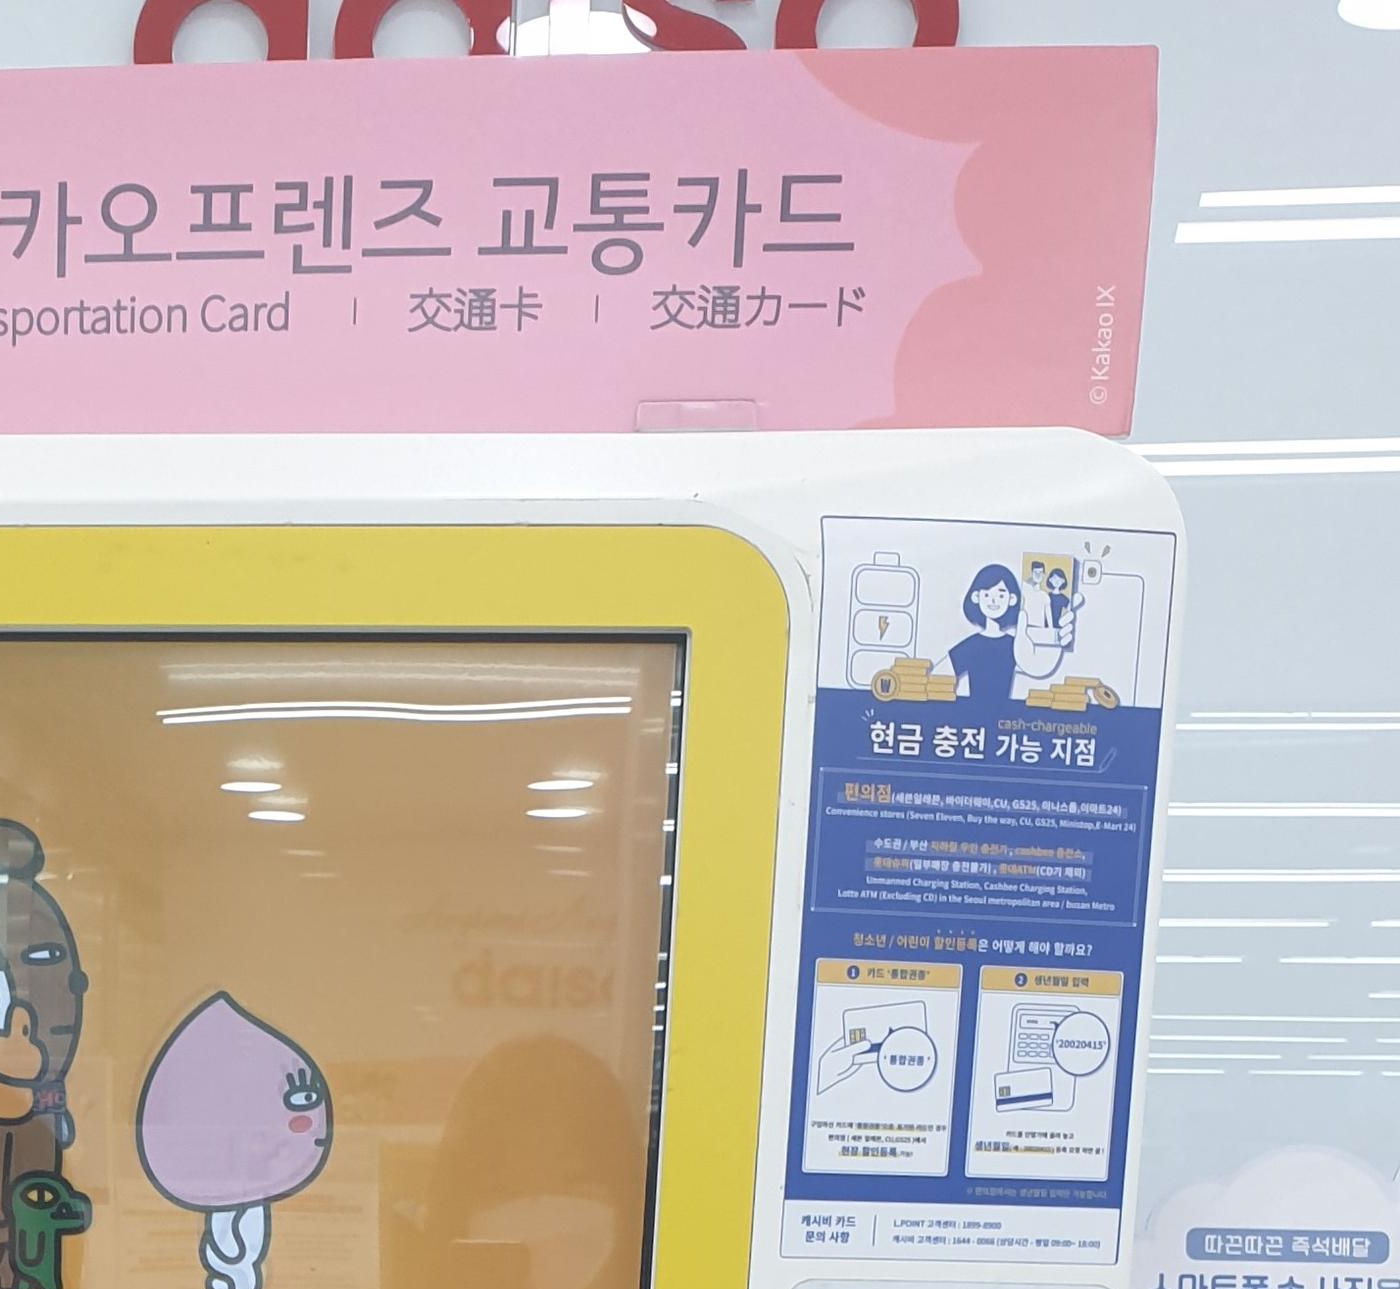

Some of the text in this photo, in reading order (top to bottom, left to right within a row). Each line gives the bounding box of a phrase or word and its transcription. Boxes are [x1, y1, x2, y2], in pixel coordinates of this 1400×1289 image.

[477, 167, 855, 276] 교통카드
[200, 291, 290, 334] Card
[407, 285, 543, 333] 交通卡
[650, 284, 866, 331] 交通カード
[1090, 313, 1114, 380] Kakao
[870, 720, 1096, 767] 현금 충전 가능 지점
[998, 718, 1097, 736] cash-chargeable
[853, 932, 887, 950] 청소년
[896, 934, 931, 951] 어린이
[1028, 941, 1051, 956] 해야
[805, 1230, 850, 1244] 문의 사항
[835, 1215, 856, 1228] 카드
[1204, 1234, 1372, 1258] 따끈따끈 즉석배달
